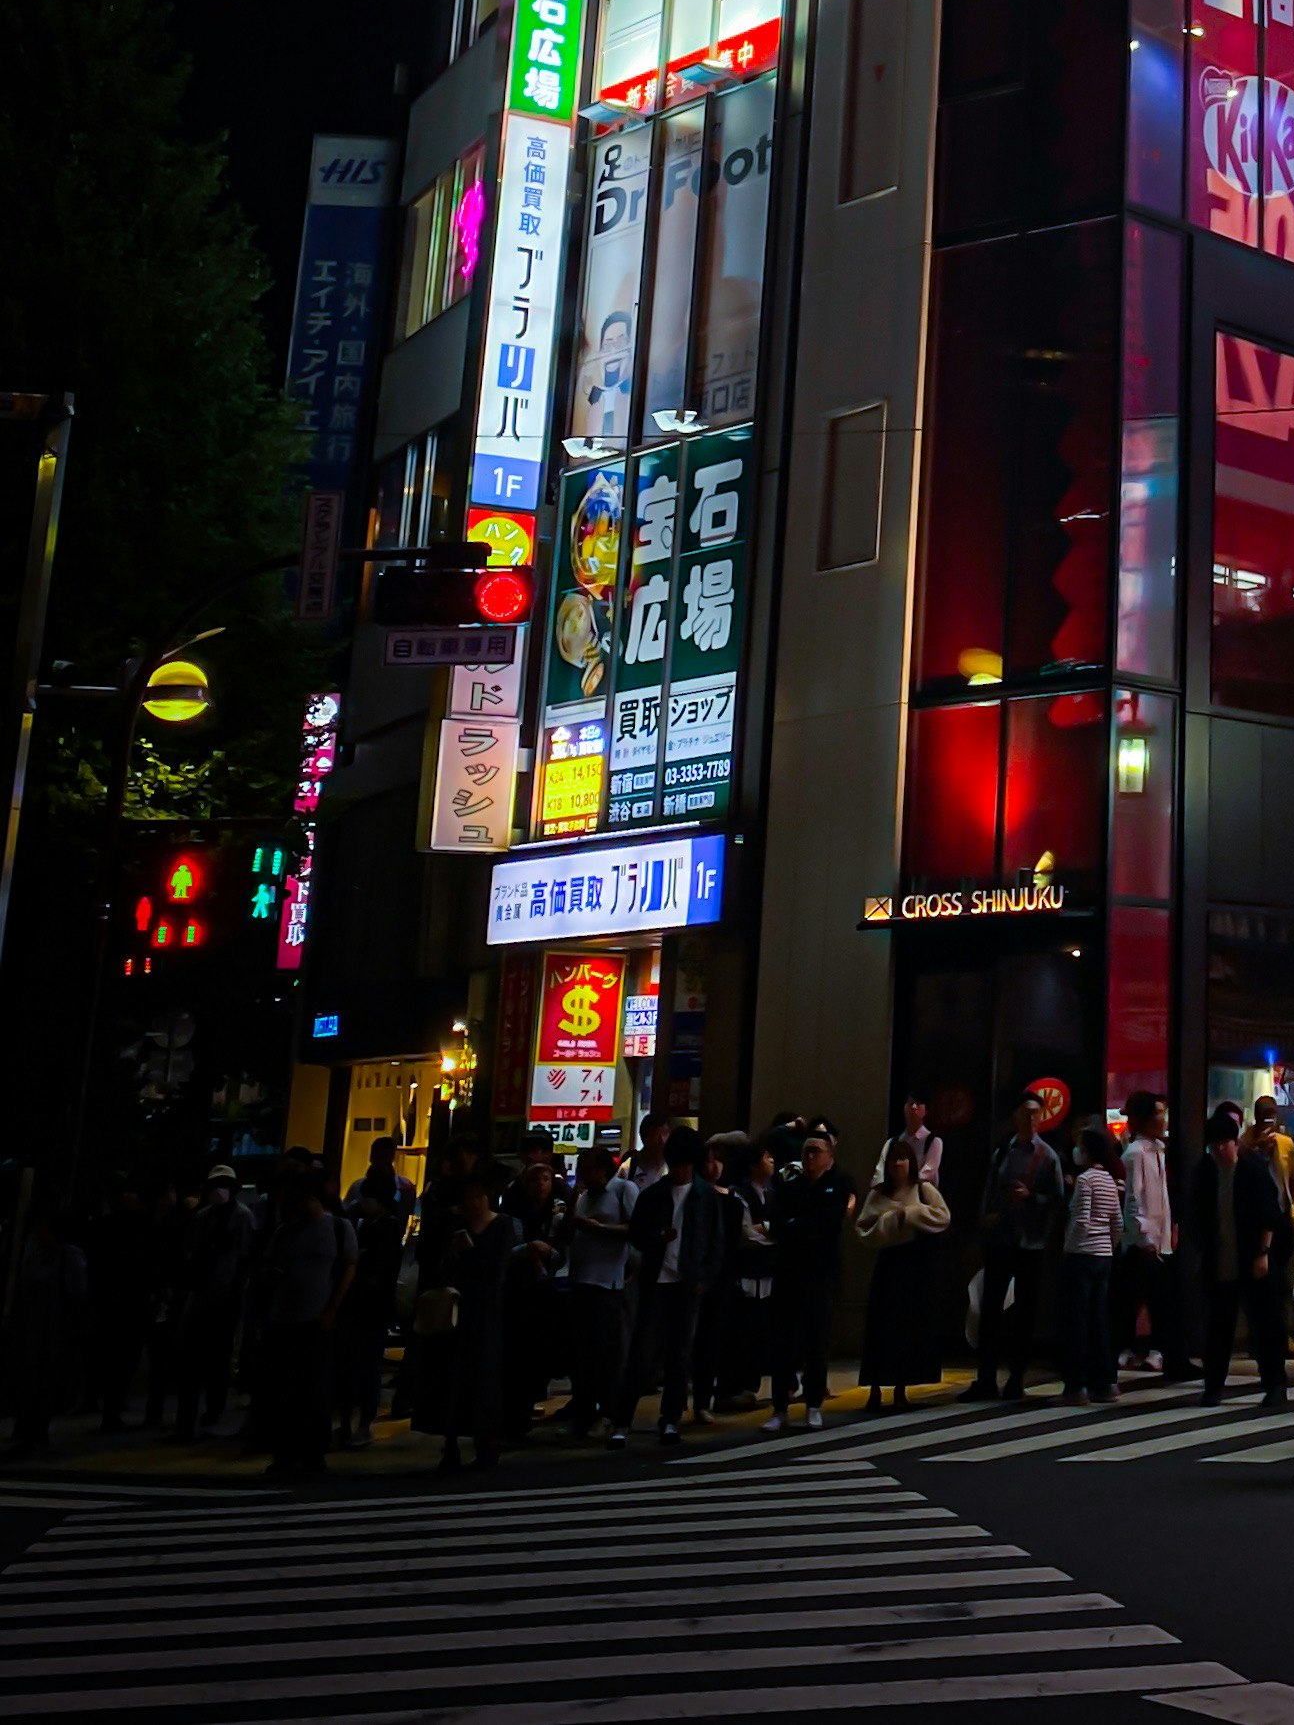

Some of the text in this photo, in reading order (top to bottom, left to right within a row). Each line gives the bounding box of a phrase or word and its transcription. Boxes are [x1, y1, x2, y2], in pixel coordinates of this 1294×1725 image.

[518, 136, 549, 237] 高価買取
[494, 466, 522, 498] 1F
[529, 876, 604, 919] 高価買取
[901, 884, 1065, 919] CROSS SHINJUKU
